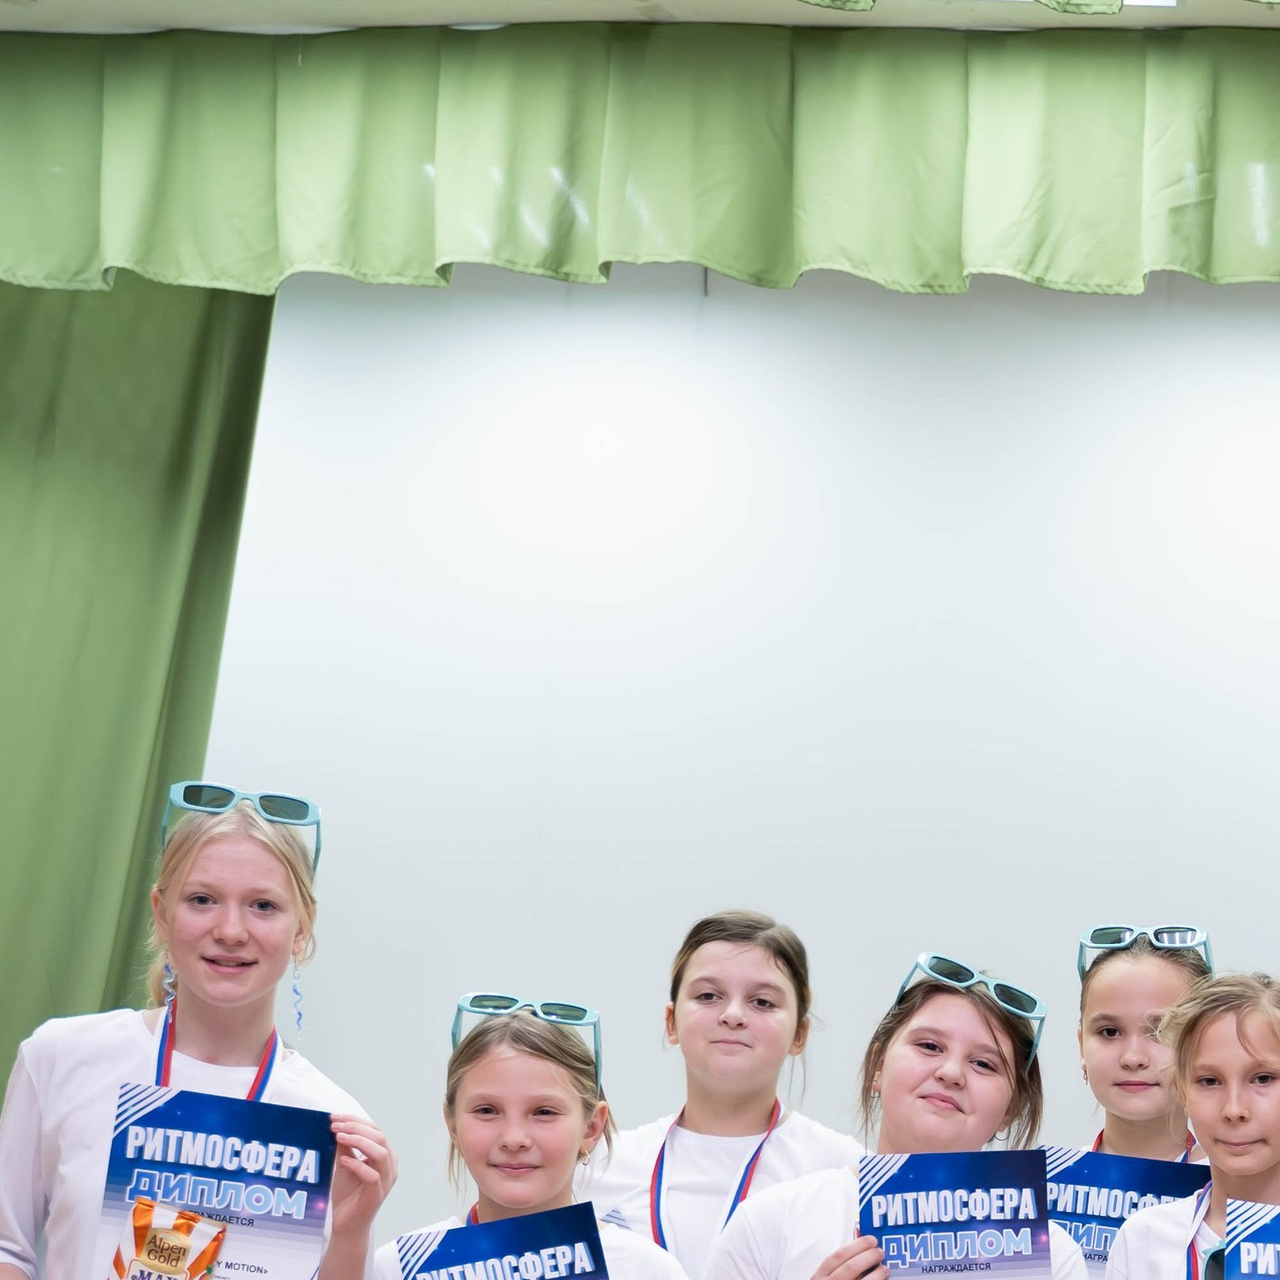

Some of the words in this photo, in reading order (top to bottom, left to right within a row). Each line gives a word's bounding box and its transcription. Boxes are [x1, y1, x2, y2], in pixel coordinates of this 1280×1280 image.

[126, 1125, 320, 1184] РИТМОСФЕРА
[126, 1169, 307, 1219] ДИПЛОМ
[872, 1188, 1037, 1228] РИТМОСФЕРА
[147, 1234, 187, 1256] Alpen
[147, 1249, 180, 1268] Gold
[882, 1227, 1032, 1269] ДИПЛОМ
[225, 1261, 268, 1275] MOTION»
[922, 1262, 991, 1274] НАГРАЖДАЕТСЯ
